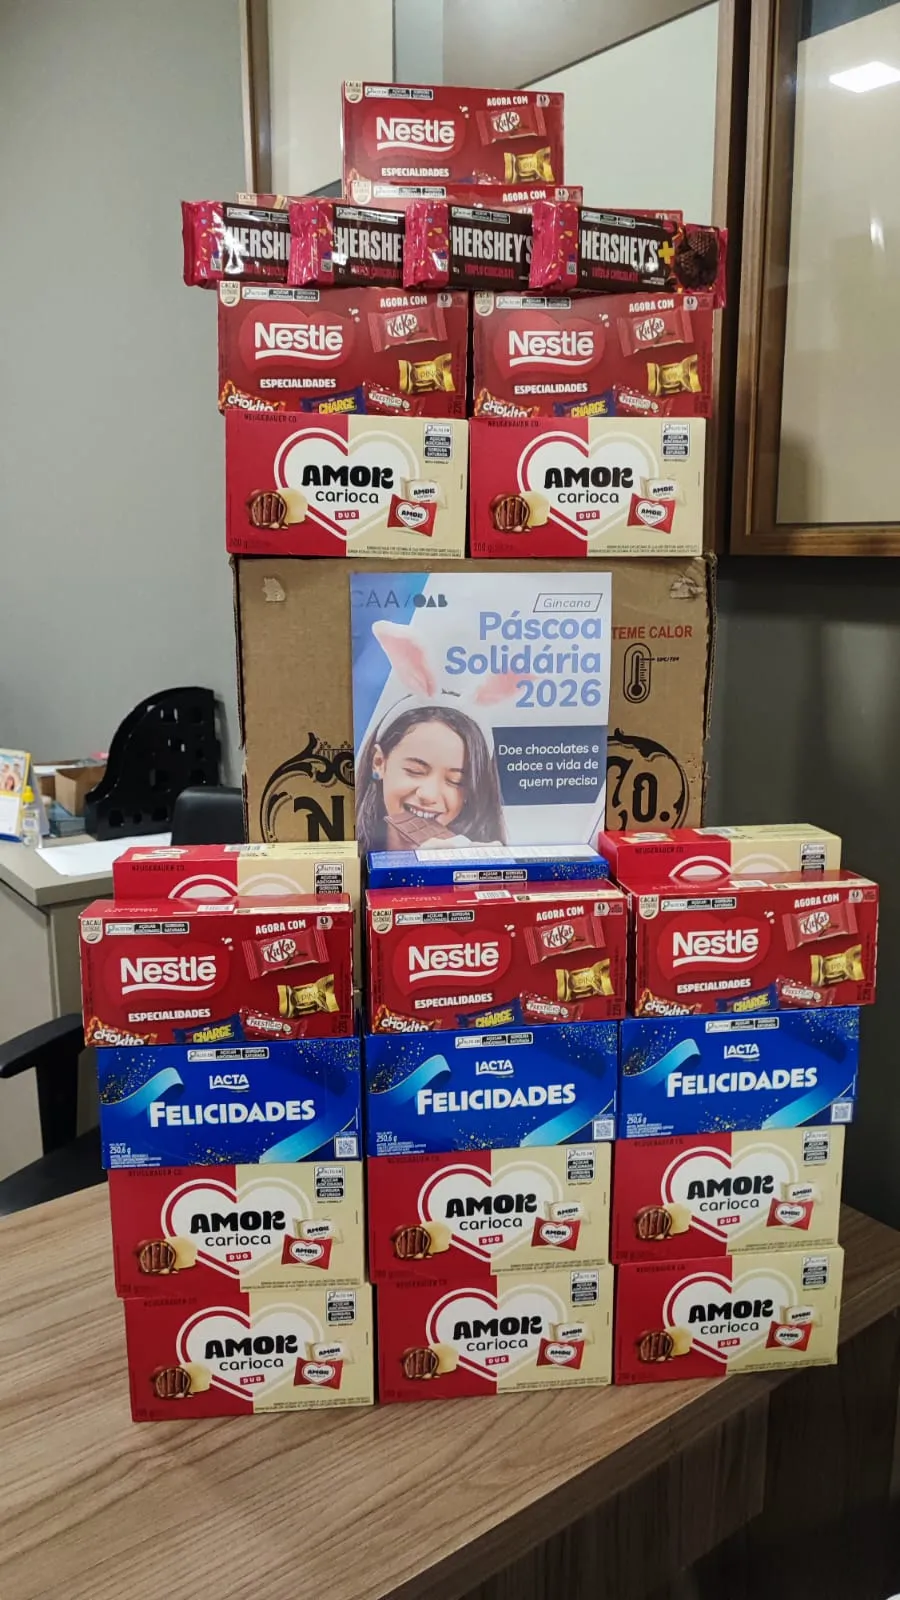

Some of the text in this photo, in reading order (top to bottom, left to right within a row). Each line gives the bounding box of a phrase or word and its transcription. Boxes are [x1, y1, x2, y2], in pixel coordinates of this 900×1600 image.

[487, 96, 528, 106] AGORA COM
[382, 168, 449, 177] ESPECIALIDADES
[503, 190, 546, 202] AGORA COM
[337, 227, 405, 262] HERSHE
[380, 296, 427, 308] AGORA COM
[629, 300, 674, 313] AGORA COM
[260, 379, 336, 388] ESPECIALIDADES
[515, 383, 587, 394] ESPECIALIDADES
[319, 396, 355, 414] CHARGE
[571, 400, 606, 417] CHARGE
[302, 464, 394, 489] AMOR
[544, 466, 634, 488] AMOR
[316, 490, 379, 504] carioca
[558, 490, 619, 504] carioca
[543, 598, 591, 608] Gincana
[479, 611, 601, 640] Páscoa
[650, 626, 692, 638] CALOR
[445, 644, 600, 674] Solidária
[516, 679, 601, 707] 2026
[499, 745, 523, 755] Doe
[526, 744, 588, 755] chocolates
[507, 761, 543, 772] adoce
[557, 760, 581, 770] vida
[584, 760, 598, 769] de
[519, 776, 597, 790] quem precisa
[794, 894, 839, 908] AGORA COM
[536, 906, 584, 921] AGORA COM
[255, 920, 305, 934] AGORA COM
[801, 912, 829, 934] KitKat
[543, 925, 574, 948] KitKat
[264, 939, 296, 962] KitKat
[677, 979, 751, 993] ESPECIALIDADES
[415, 993, 492, 1008] ESPECIALIDADES
[733, 994, 770, 1012] CHARGE
[128, 1008, 210, 1022] ESPECIALIDADES
[475, 1009, 514, 1027] CHARGE
[193, 1024, 234, 1042] CHARGE
[724, 1044, 760, 1059] LACTA
[476, 1060, 514, 1076] LACTA
[210, 1074, 249, 1089] LACTA
[667, 1067, 817, 1098] FELICIDADES
[417, 1084, 576, 1115] FELICIDADES
[150, 1100, 316, 1128] FELICIDADES
[687, 1175, 774, 1200] AMOR
[445, 1194, 537, 1218] AMOR
[699, 1197, 759, 1212] carioca
[190, 1210, 286, 1233] AMOR
[459, 1217, 522, 1231] carioca
[205, 1234, 271, 1247] carioca
[688, 1299, 773, 1323] AMOR
[453, 1316, 542, 1340] AMOR
[700, 1322, 759, 1335] carioca
[204, 1335, 298, 1359] AMOR
[466, 1338, 528, 1352] carioca
[219, 1357, 284, 1371] carioca
